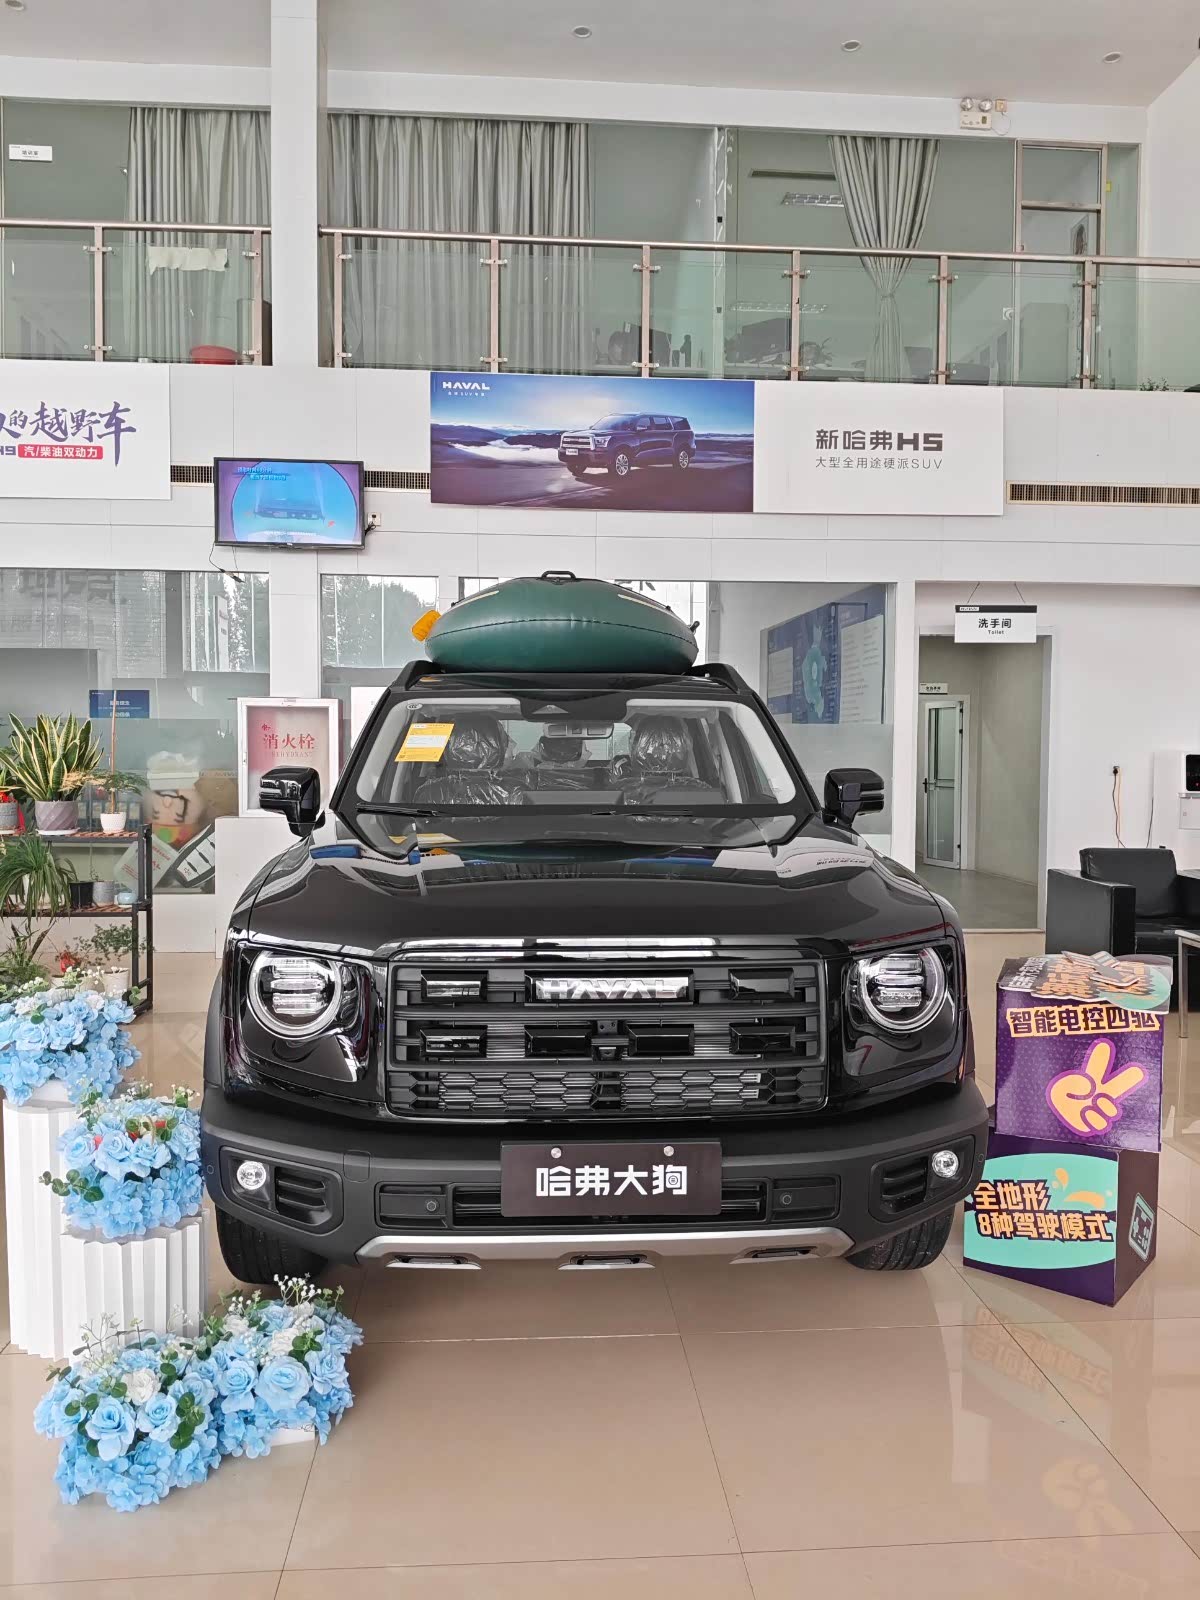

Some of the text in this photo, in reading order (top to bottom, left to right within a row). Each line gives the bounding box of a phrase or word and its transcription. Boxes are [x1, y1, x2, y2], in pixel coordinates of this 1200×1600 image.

[442, 381, 490, 390] HAVAL
[23, 445, 98, 458] 汽/柴油双动力
[815, 456, 943, 470] 大型全用途硬派SUV
[978, 617, 1012, 629] 洗手间
[262, 732, 316, 750] 消火栓
[542, 979, 678, 999] HAVAL
[1009, 1005, 1157, 1035] 智能电控四驱
[535, 1164, 688, 1197] 哈弗大狗
[973, 1181, 1049, 1211] 全地形
[977, 1211, 1114, 1241] 8种驾驶模式
